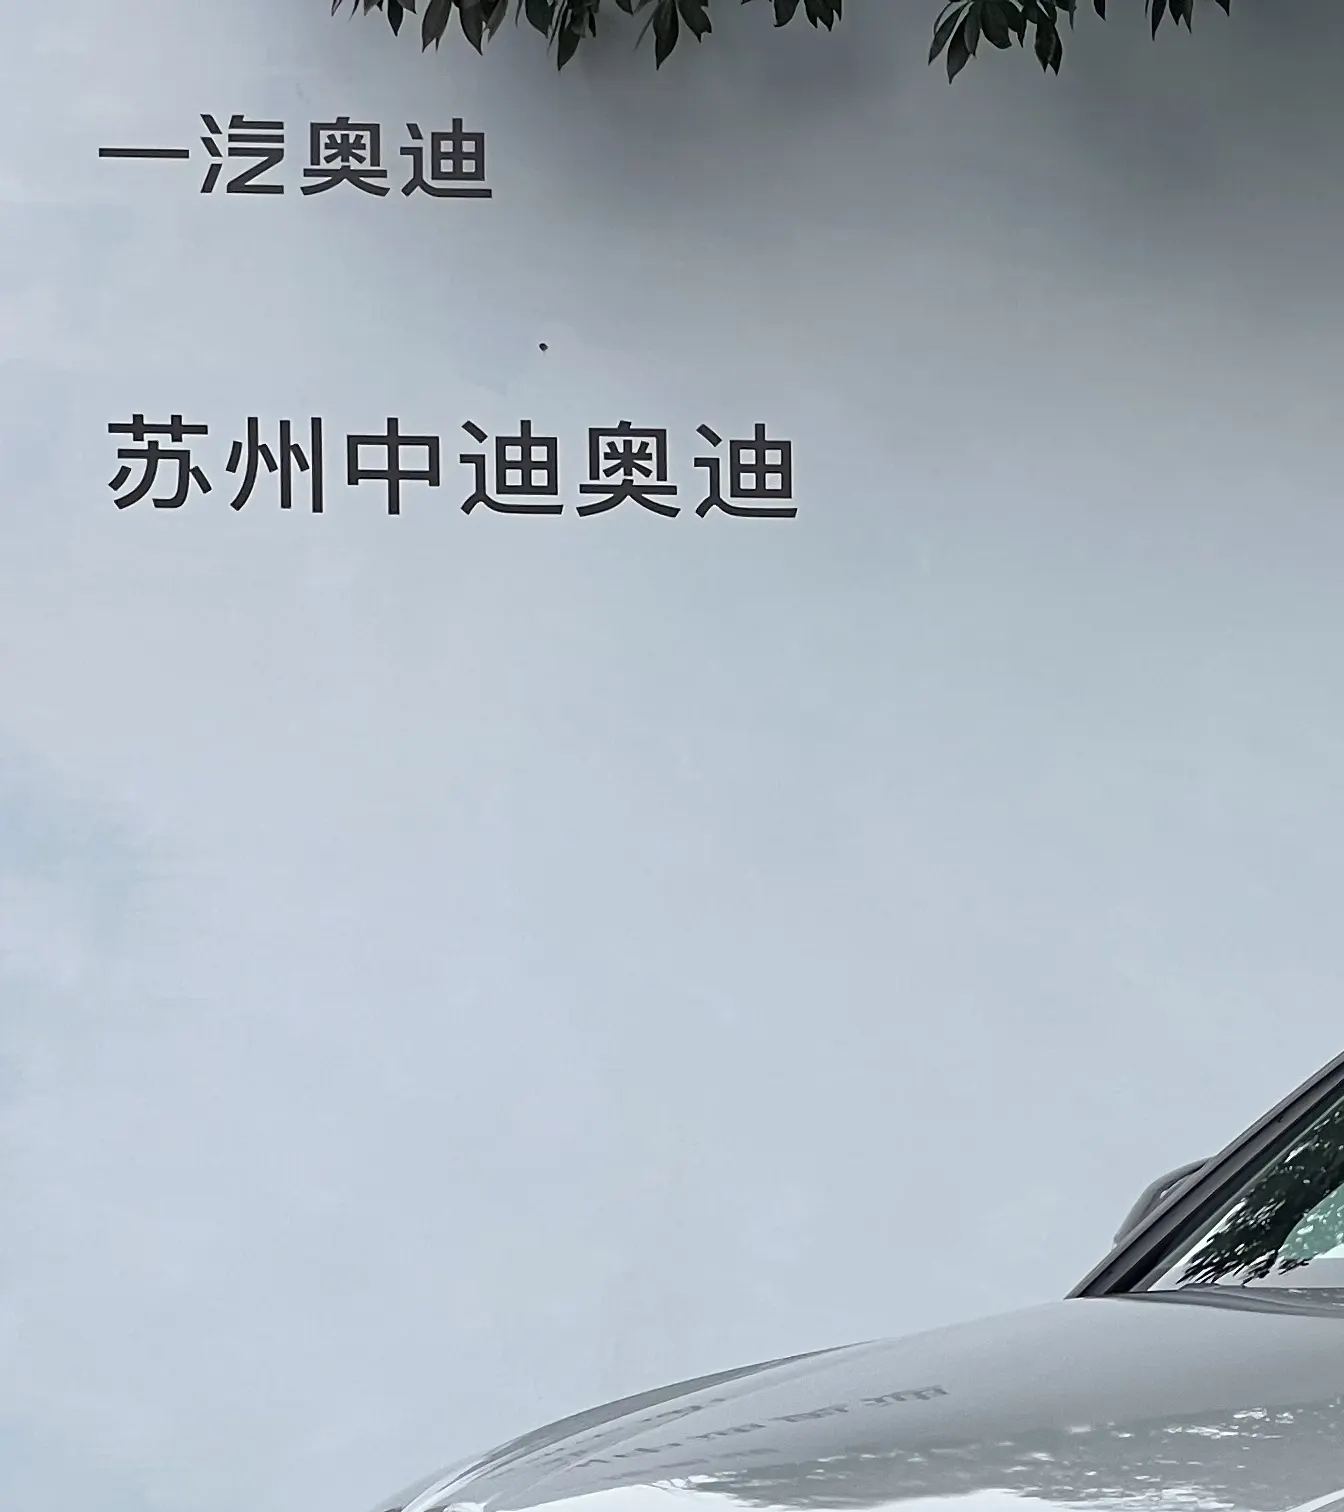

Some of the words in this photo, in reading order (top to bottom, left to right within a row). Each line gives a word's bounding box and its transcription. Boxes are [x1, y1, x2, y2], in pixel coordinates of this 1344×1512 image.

[98, 113, 493, 198] 一汽奥迪
[107, 413, 799, 518] 苏州中迪奥迪
